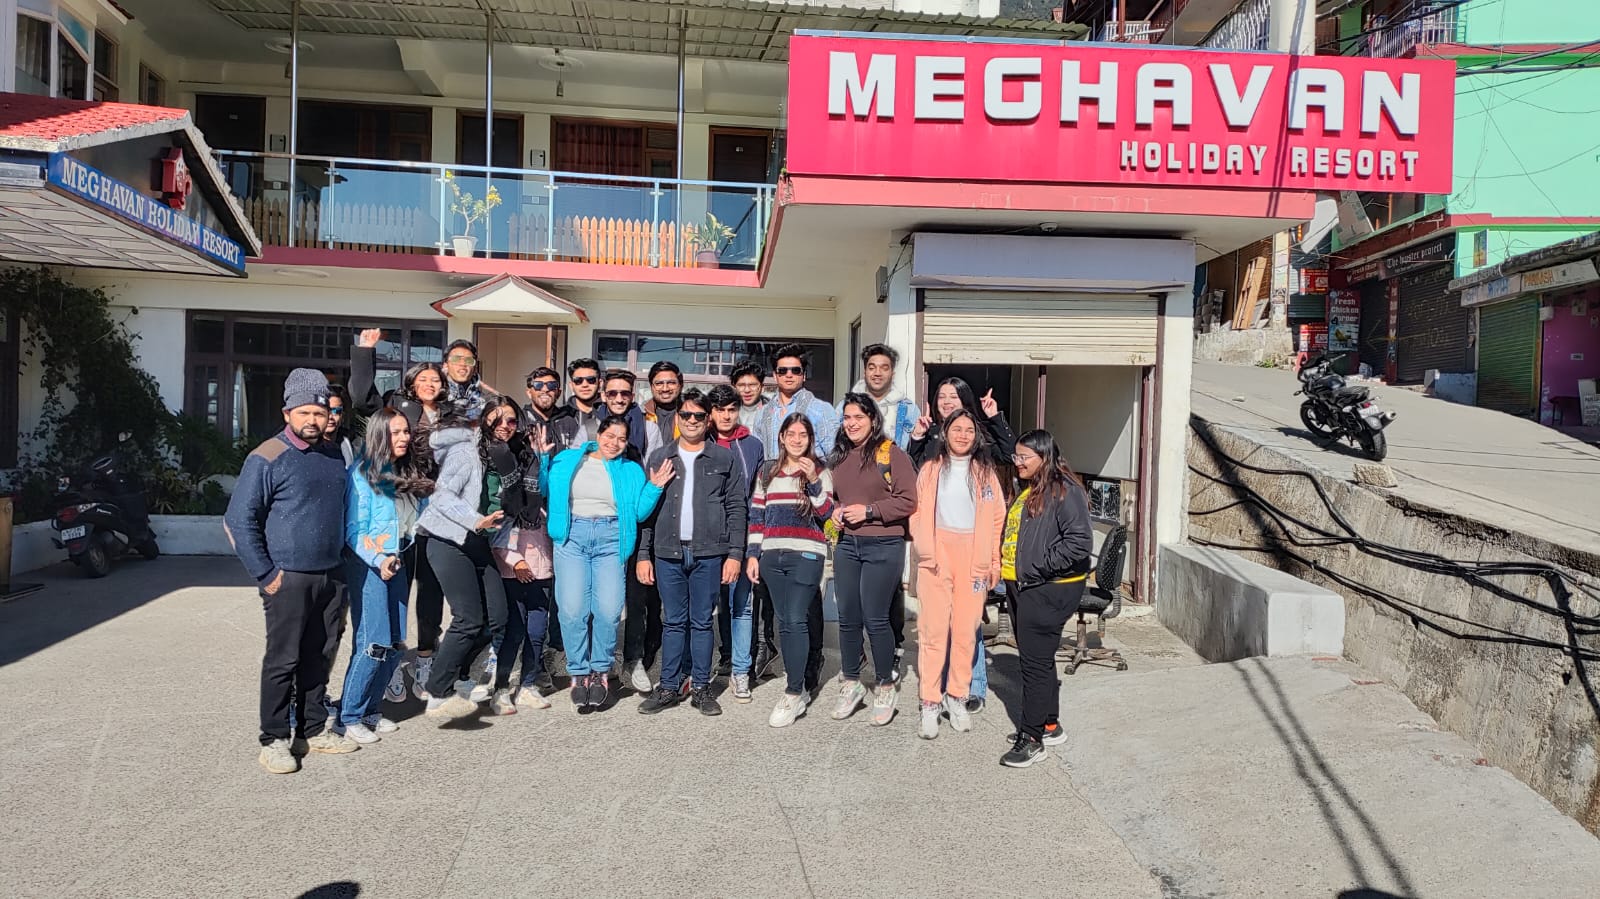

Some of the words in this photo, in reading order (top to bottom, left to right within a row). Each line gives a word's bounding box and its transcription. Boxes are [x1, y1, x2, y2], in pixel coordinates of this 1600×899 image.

[827, 50, 1422, 135] MEGHAVAN
[1120, 140, 1268, 174] HOLIDAY
[1290, 146, 1419, 180] RESORT
[61, 157, 145, 221] MEGHAVAN
[148, 200, 200, 246] HOLIDAY
[202, 229, 241, 265] RESORT
[1421, 242, 1442, 259] project
